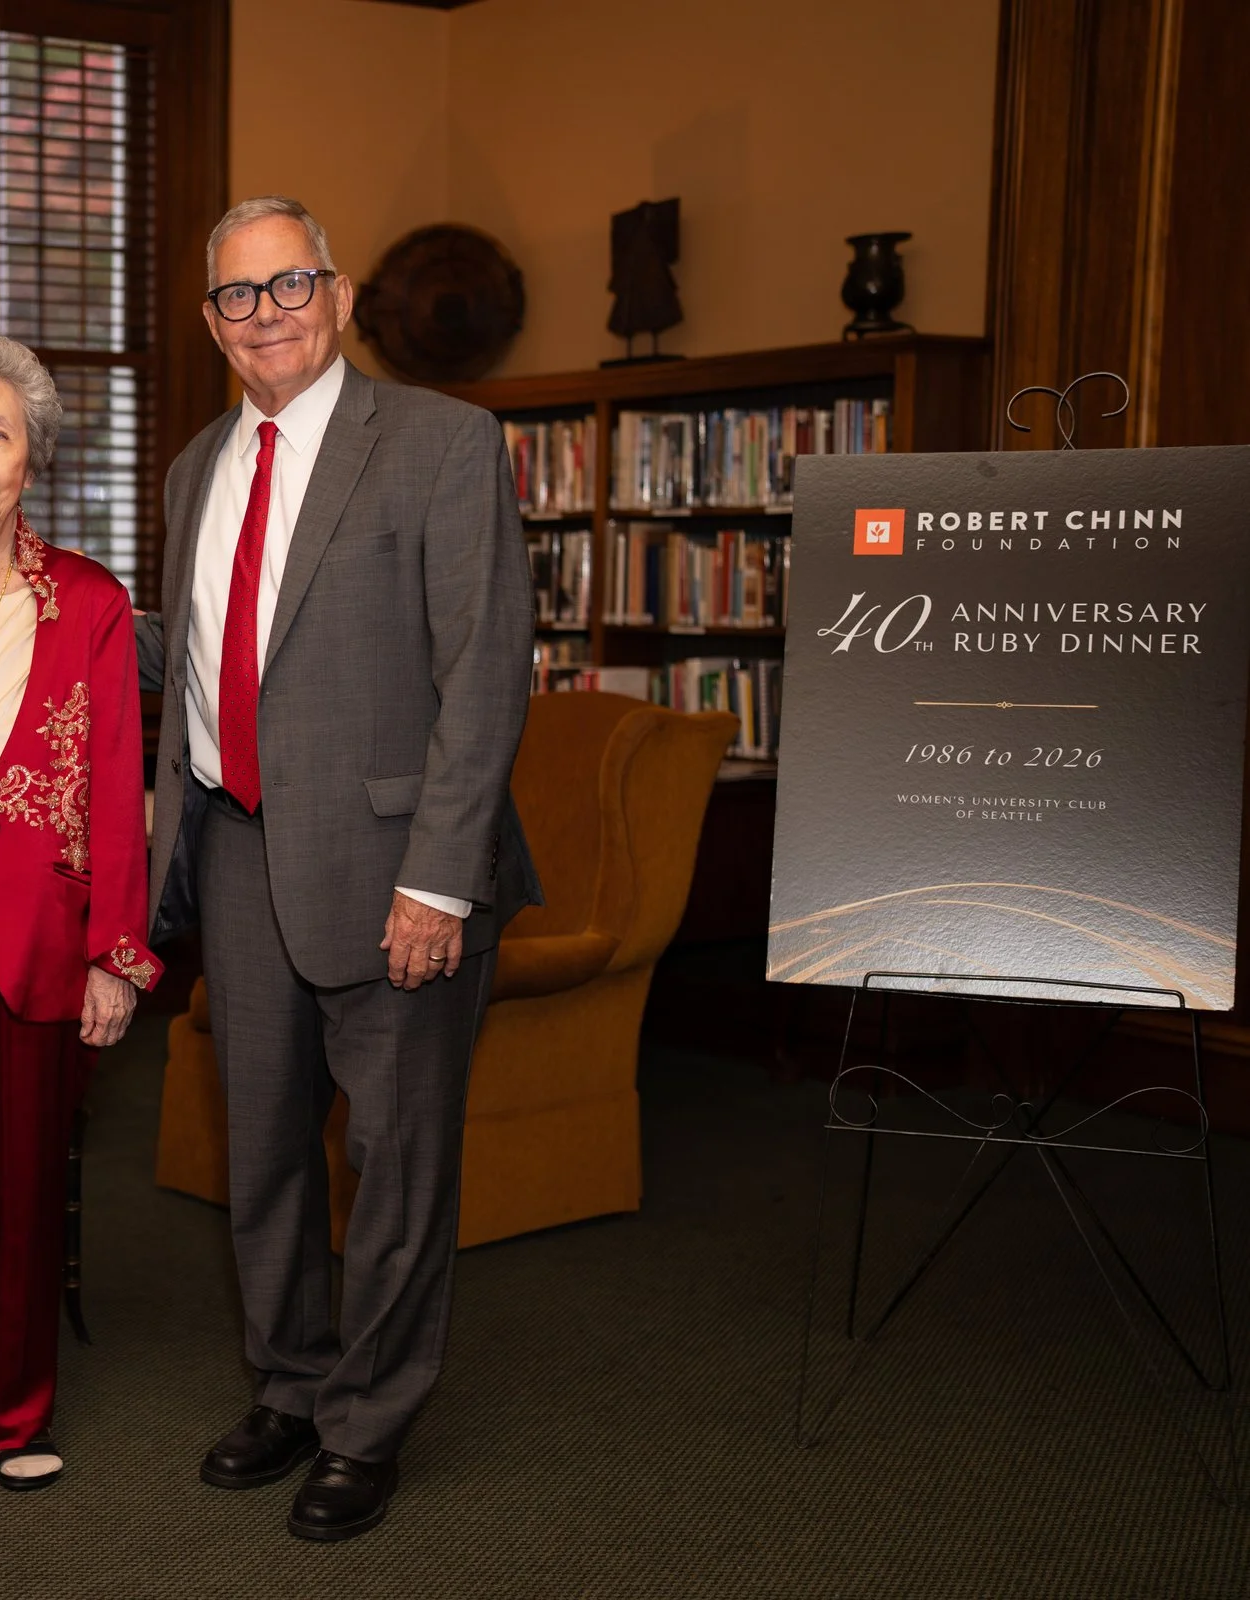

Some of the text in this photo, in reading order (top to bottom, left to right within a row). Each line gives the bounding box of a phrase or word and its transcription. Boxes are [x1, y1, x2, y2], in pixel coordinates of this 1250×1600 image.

[917, 509, 1182, 531] ROBERT CHINN
[916, 537, 1180, 550] FOUNDATION
[951, 602, 1207, 623] ANNIVERSARY
[954, 632, 1202, 654] RUBY DINNER
[904, 743, 1103, 769] 1986 to 2026
[897, 794, 1107, 810] WOMEN'S UNIVERSITY CLUB
[956, 810, 1043, 822] OF SEATTLE
